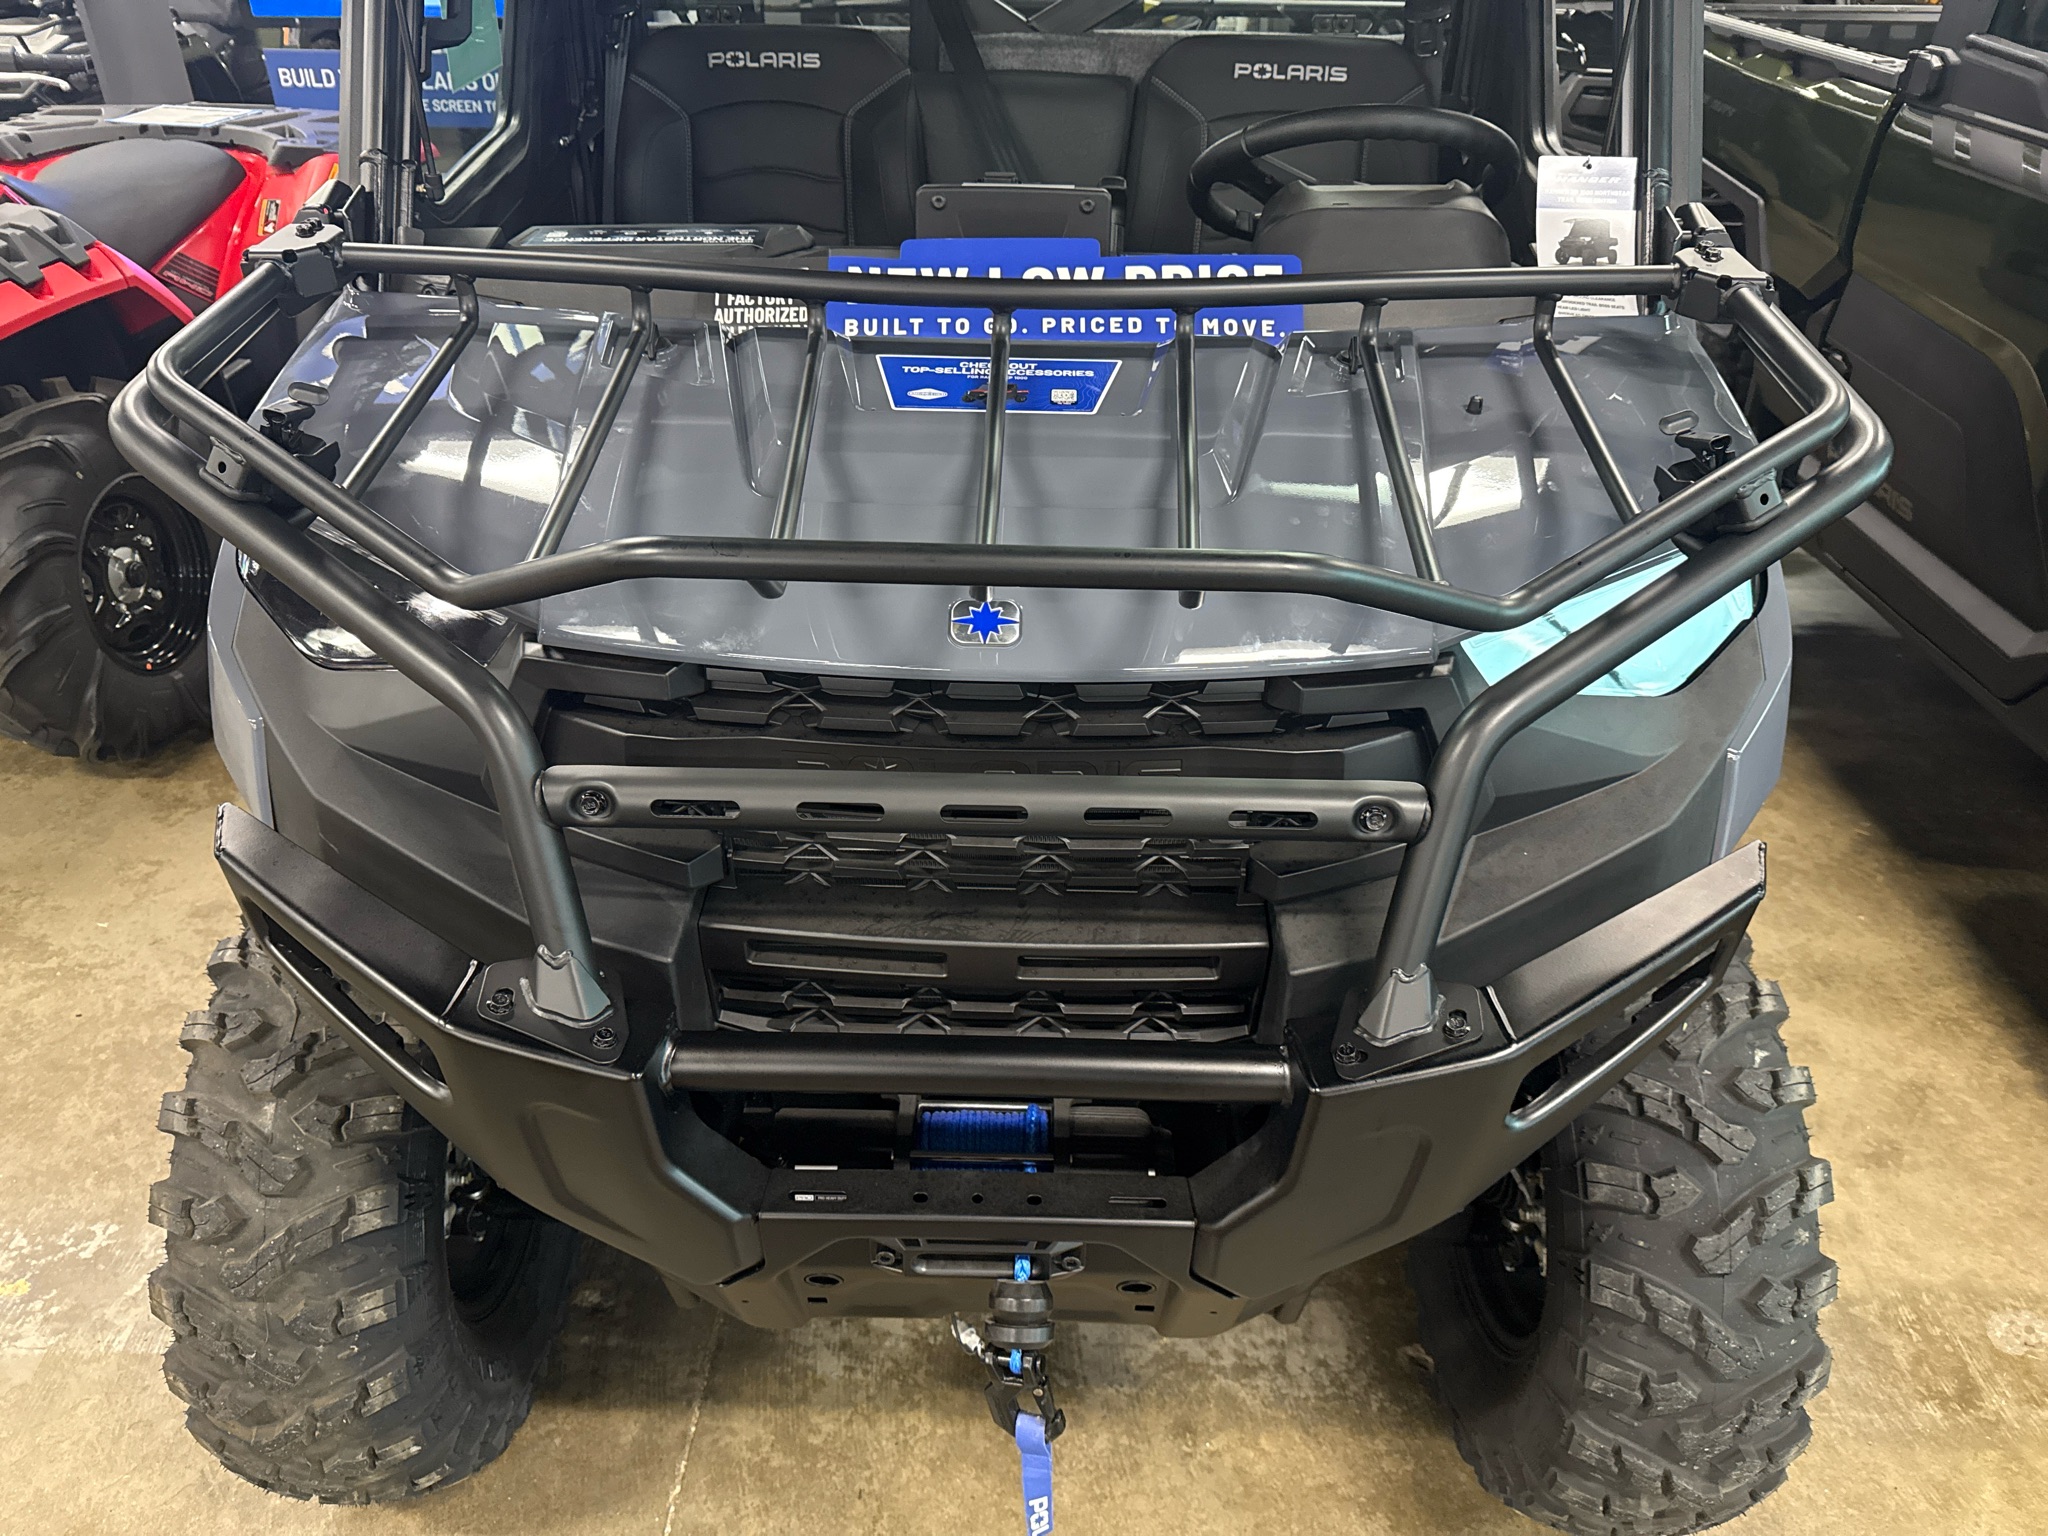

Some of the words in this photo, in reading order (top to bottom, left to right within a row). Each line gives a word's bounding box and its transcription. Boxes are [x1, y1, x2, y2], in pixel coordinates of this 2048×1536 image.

[707, 51, 821, 69] POLARIS
[277, 67, 336, 88] BUILD
[1233, 62, 1348, 82] POLARIS
[481, 72, 499, 92] O
[431, 99, 483, 113] SCREEN
[714, 307, 808, 324] AUTHORIZED
[845, 317, 924, 336] BUILT
[937, 318, 970, 335] TO
[1042, 317, 1143, 335] PRICED
[1202, 318, 1286, 337] MOVE.
[1007, 368, 1095, 378] CCESSORIES
